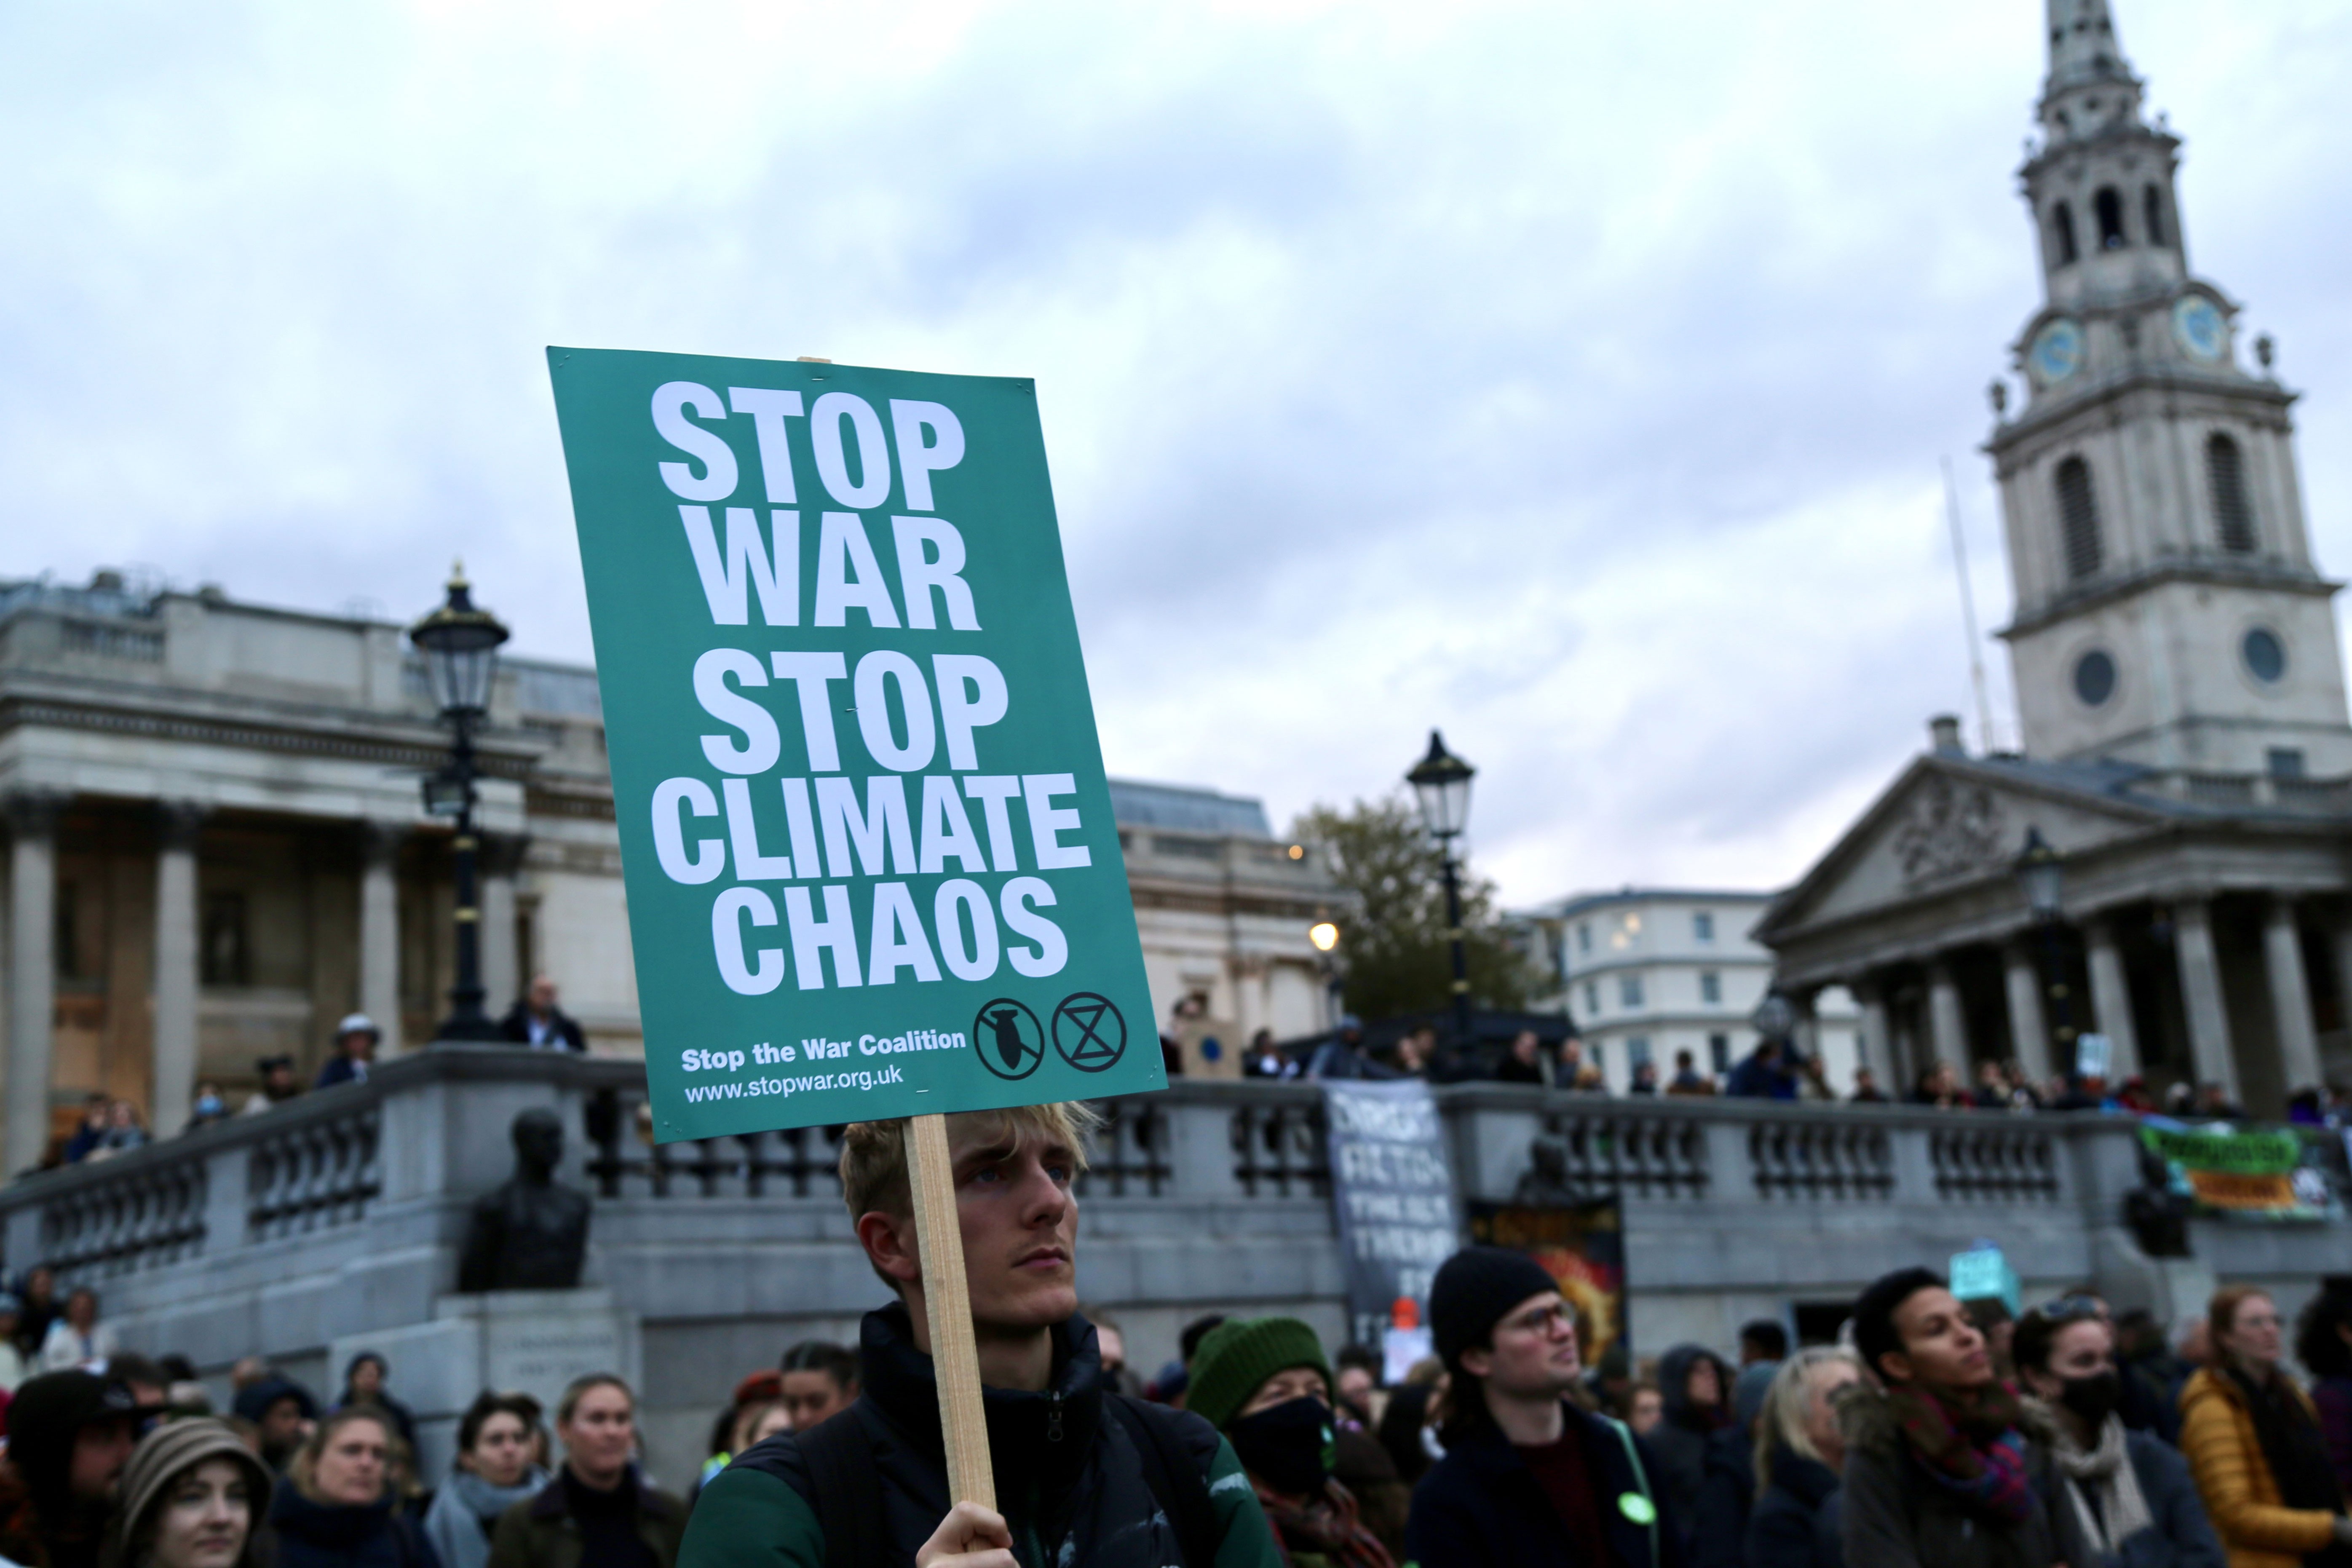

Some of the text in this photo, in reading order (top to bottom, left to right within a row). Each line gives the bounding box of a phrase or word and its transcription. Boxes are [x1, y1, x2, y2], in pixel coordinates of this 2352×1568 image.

[652, 381, 965, 511] STOP
[678, 505, 982, 631] WAR
[693, 648, 1008, 775] STOP
[652, 773, 1092, 884] CLIMATE
[712, 876, 1068, 995] CHAOS
[682, 1029, 966, 1071] Stop the War Coalition
[685, 1064, 903, 1102] www.stopwar.org.uk
